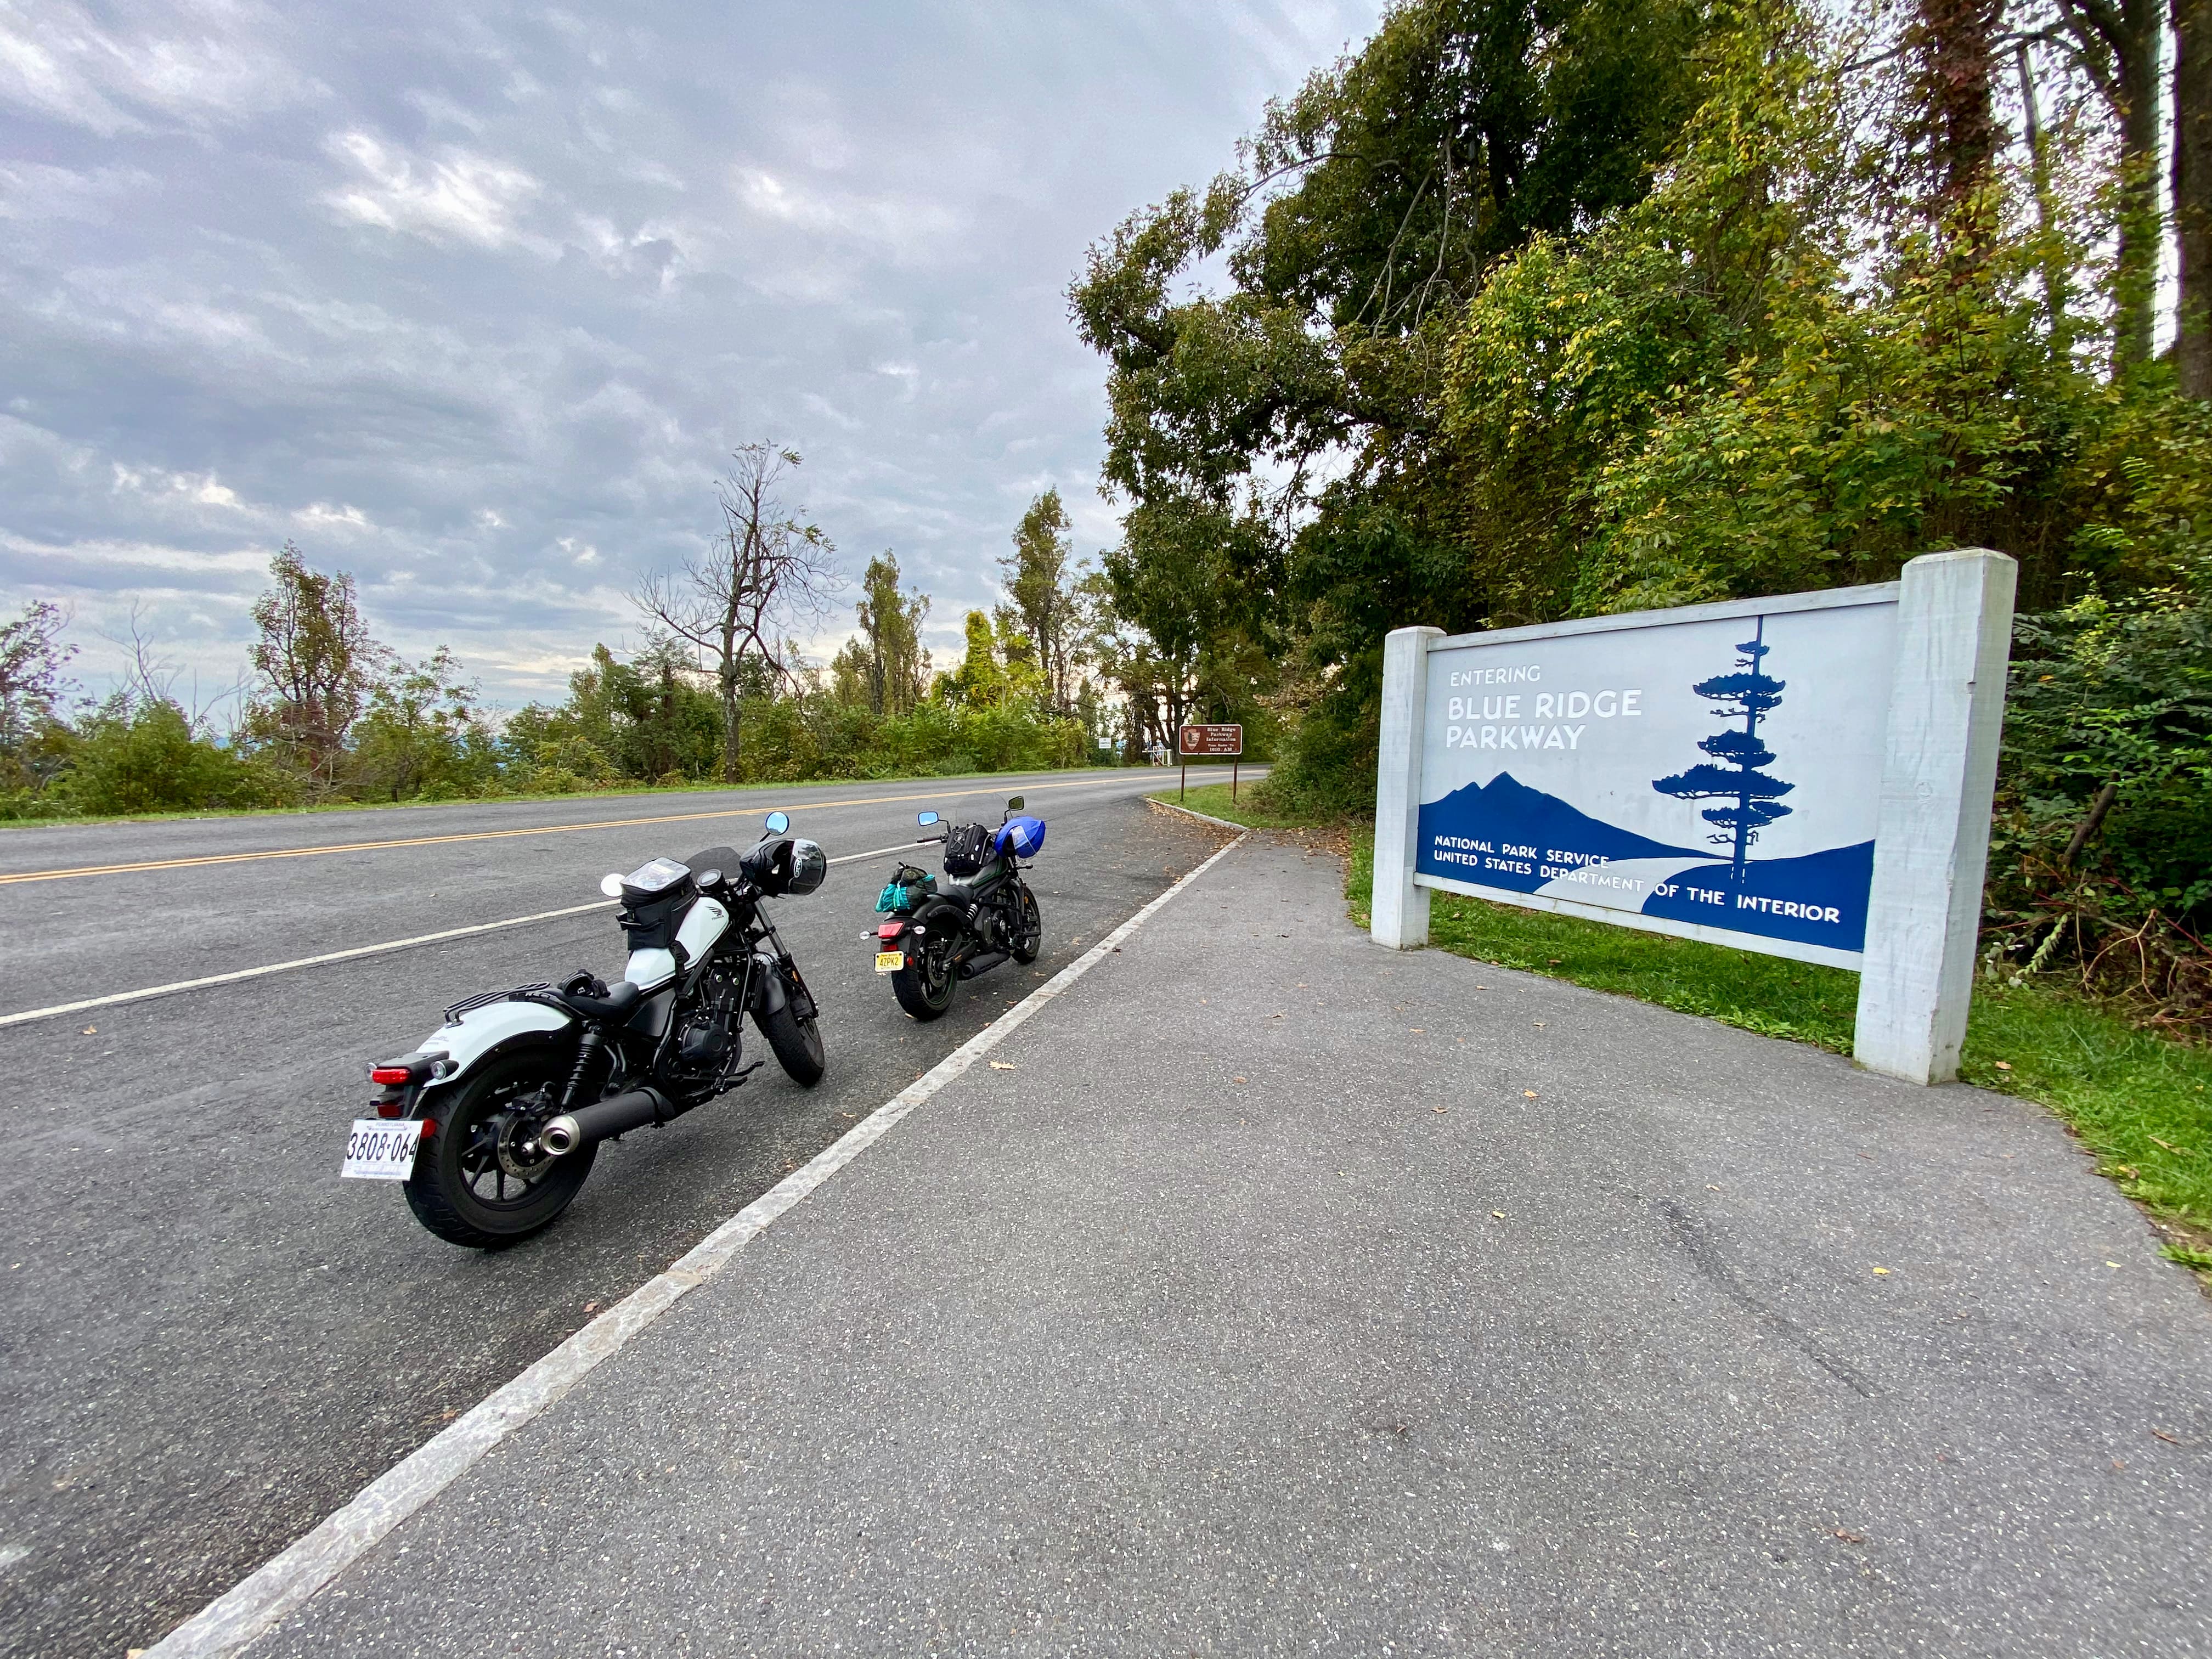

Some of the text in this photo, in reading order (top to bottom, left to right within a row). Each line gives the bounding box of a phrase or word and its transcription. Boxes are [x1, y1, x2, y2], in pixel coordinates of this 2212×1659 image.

[1450, 664, 1541, 687] ENTERING
[1448, 689, 1642, 720] BLUE RIDGE
[1446, 724, 1587, 750] PARKWAY
[1435, 835, 1609, 869] NATIONAL PARK SERVICE
[1434, 849, 1841, 923] UNITED STATES DEPARTMENT OF THE INTERIOR
[879, 956, 899, 967] 4ZPK2
